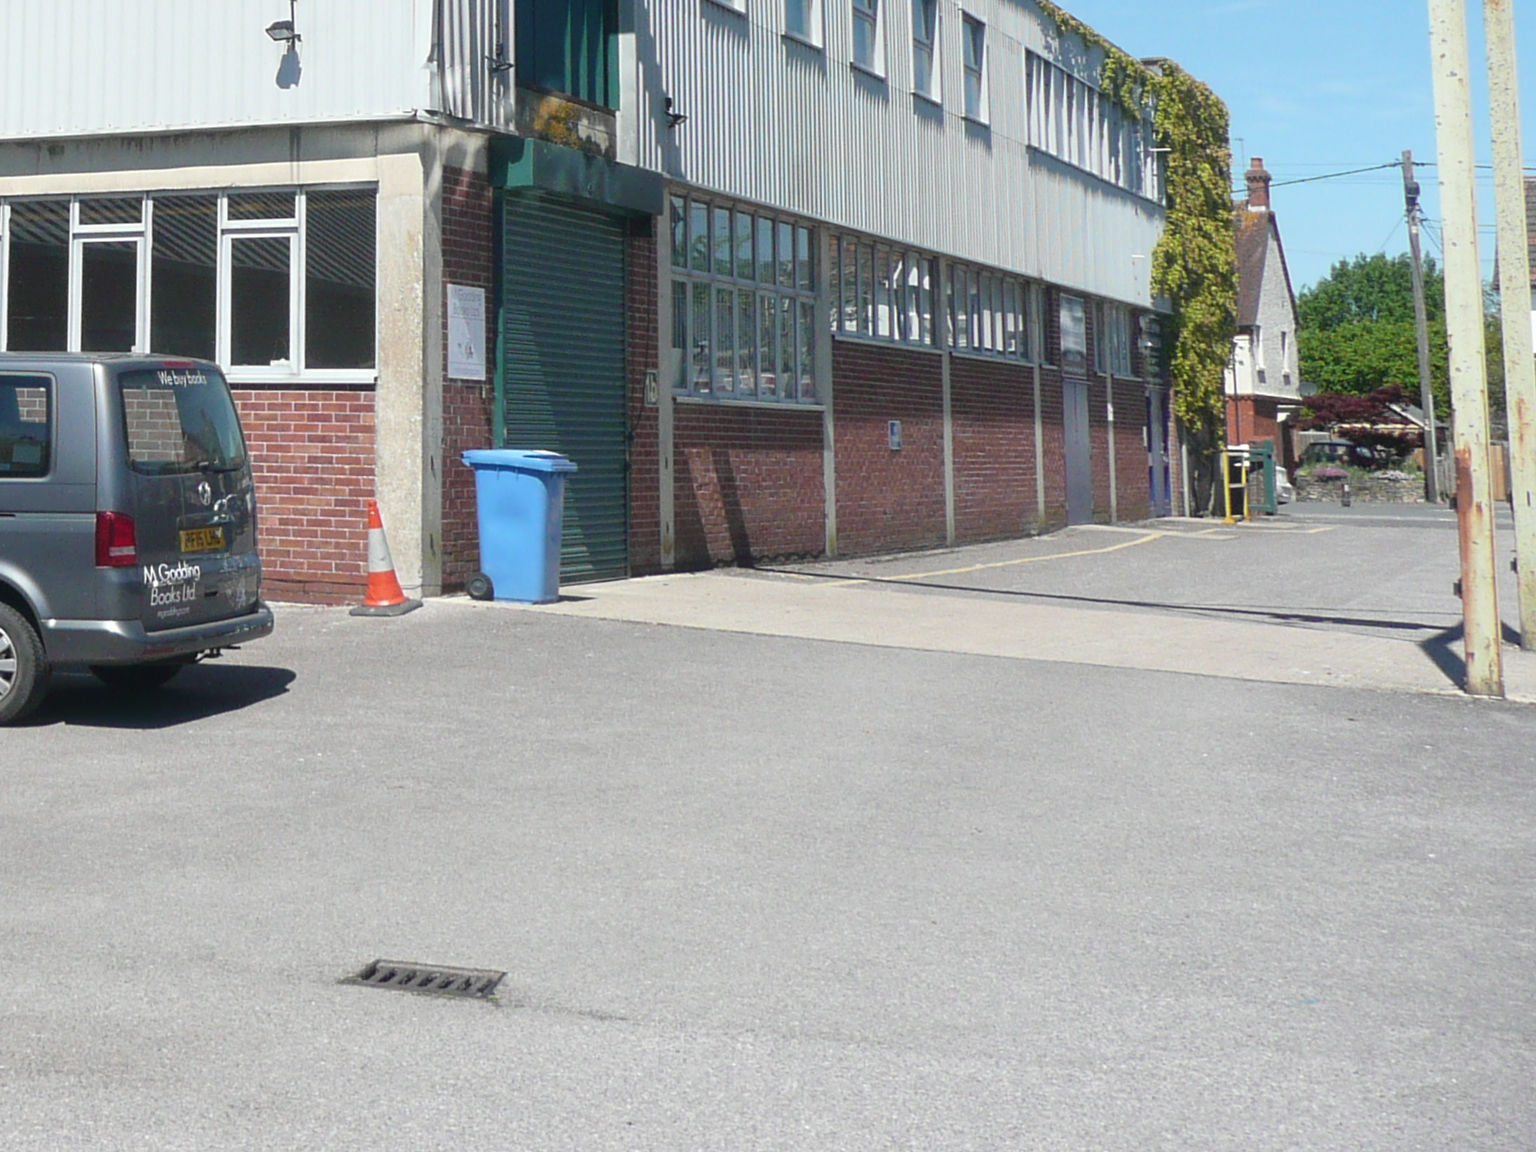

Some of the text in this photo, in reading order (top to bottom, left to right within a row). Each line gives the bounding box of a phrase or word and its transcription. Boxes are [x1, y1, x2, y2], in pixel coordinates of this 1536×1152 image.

[157, 369, 207, 388] We buy books
[158, 560, 201, 582] Godding
[150, 585, 180, 606] Books
